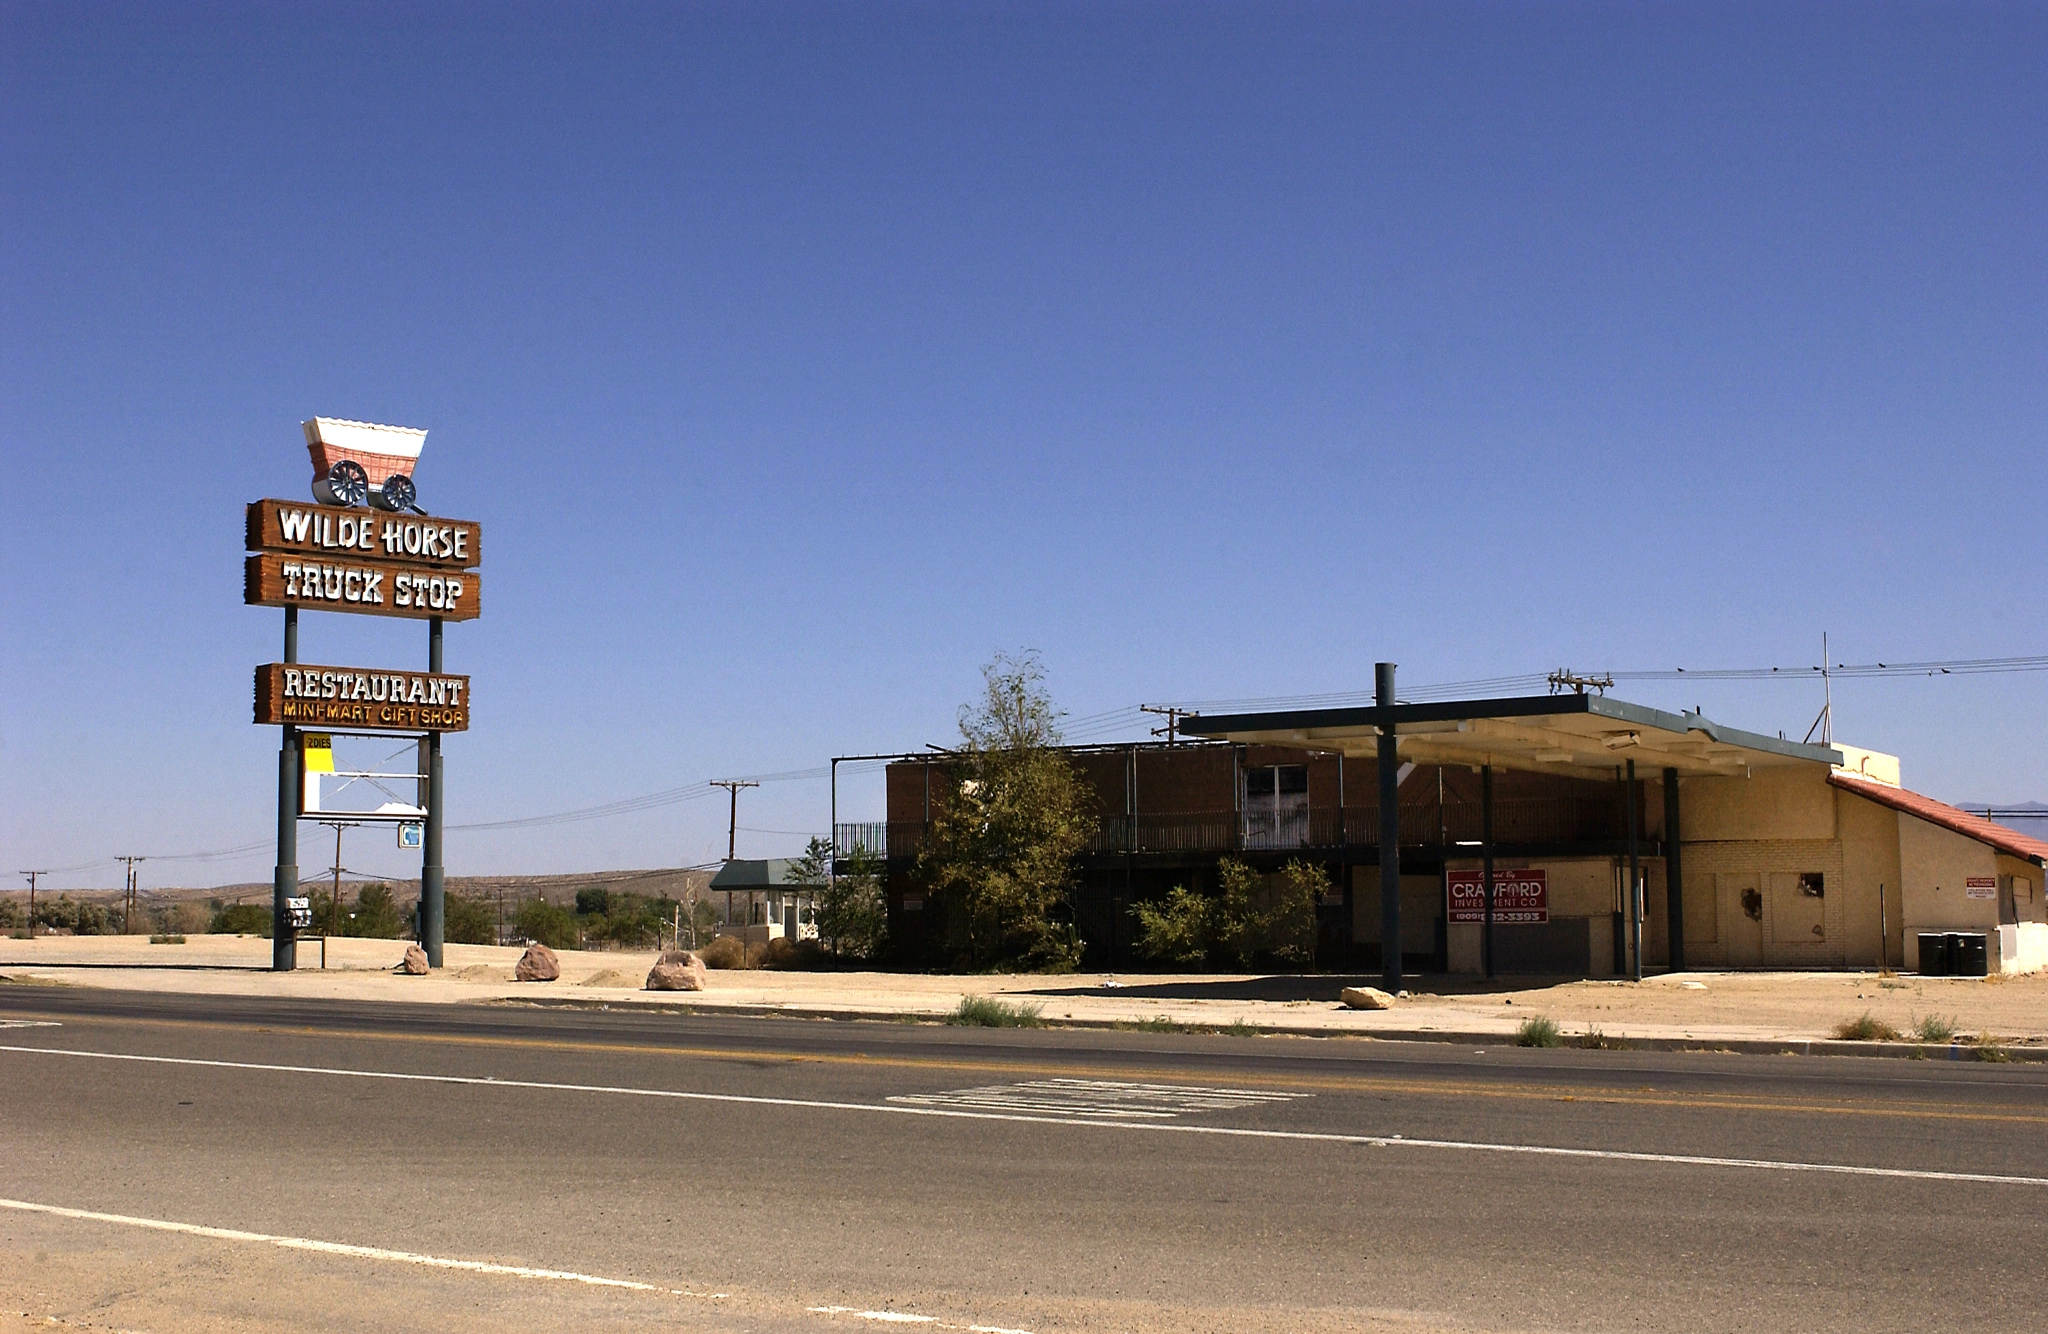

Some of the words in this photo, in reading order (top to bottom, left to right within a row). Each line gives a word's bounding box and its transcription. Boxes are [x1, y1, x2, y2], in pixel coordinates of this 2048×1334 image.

[278, 508, 375, 549] WILDE
[381, 520, 469, 559] HORSE
[283, 562, 384, 604] TRUCK
[396, 573, 464, 610] STOP
[284, 669, 463, 706] RESTAURANT
[283, 702, 372, 721] MINI-MART
[381, 706, 416, 723] GIFT
[421, 709, 463, 725] SHOP
[1455, 898, 1516, 908] INVESMENT
